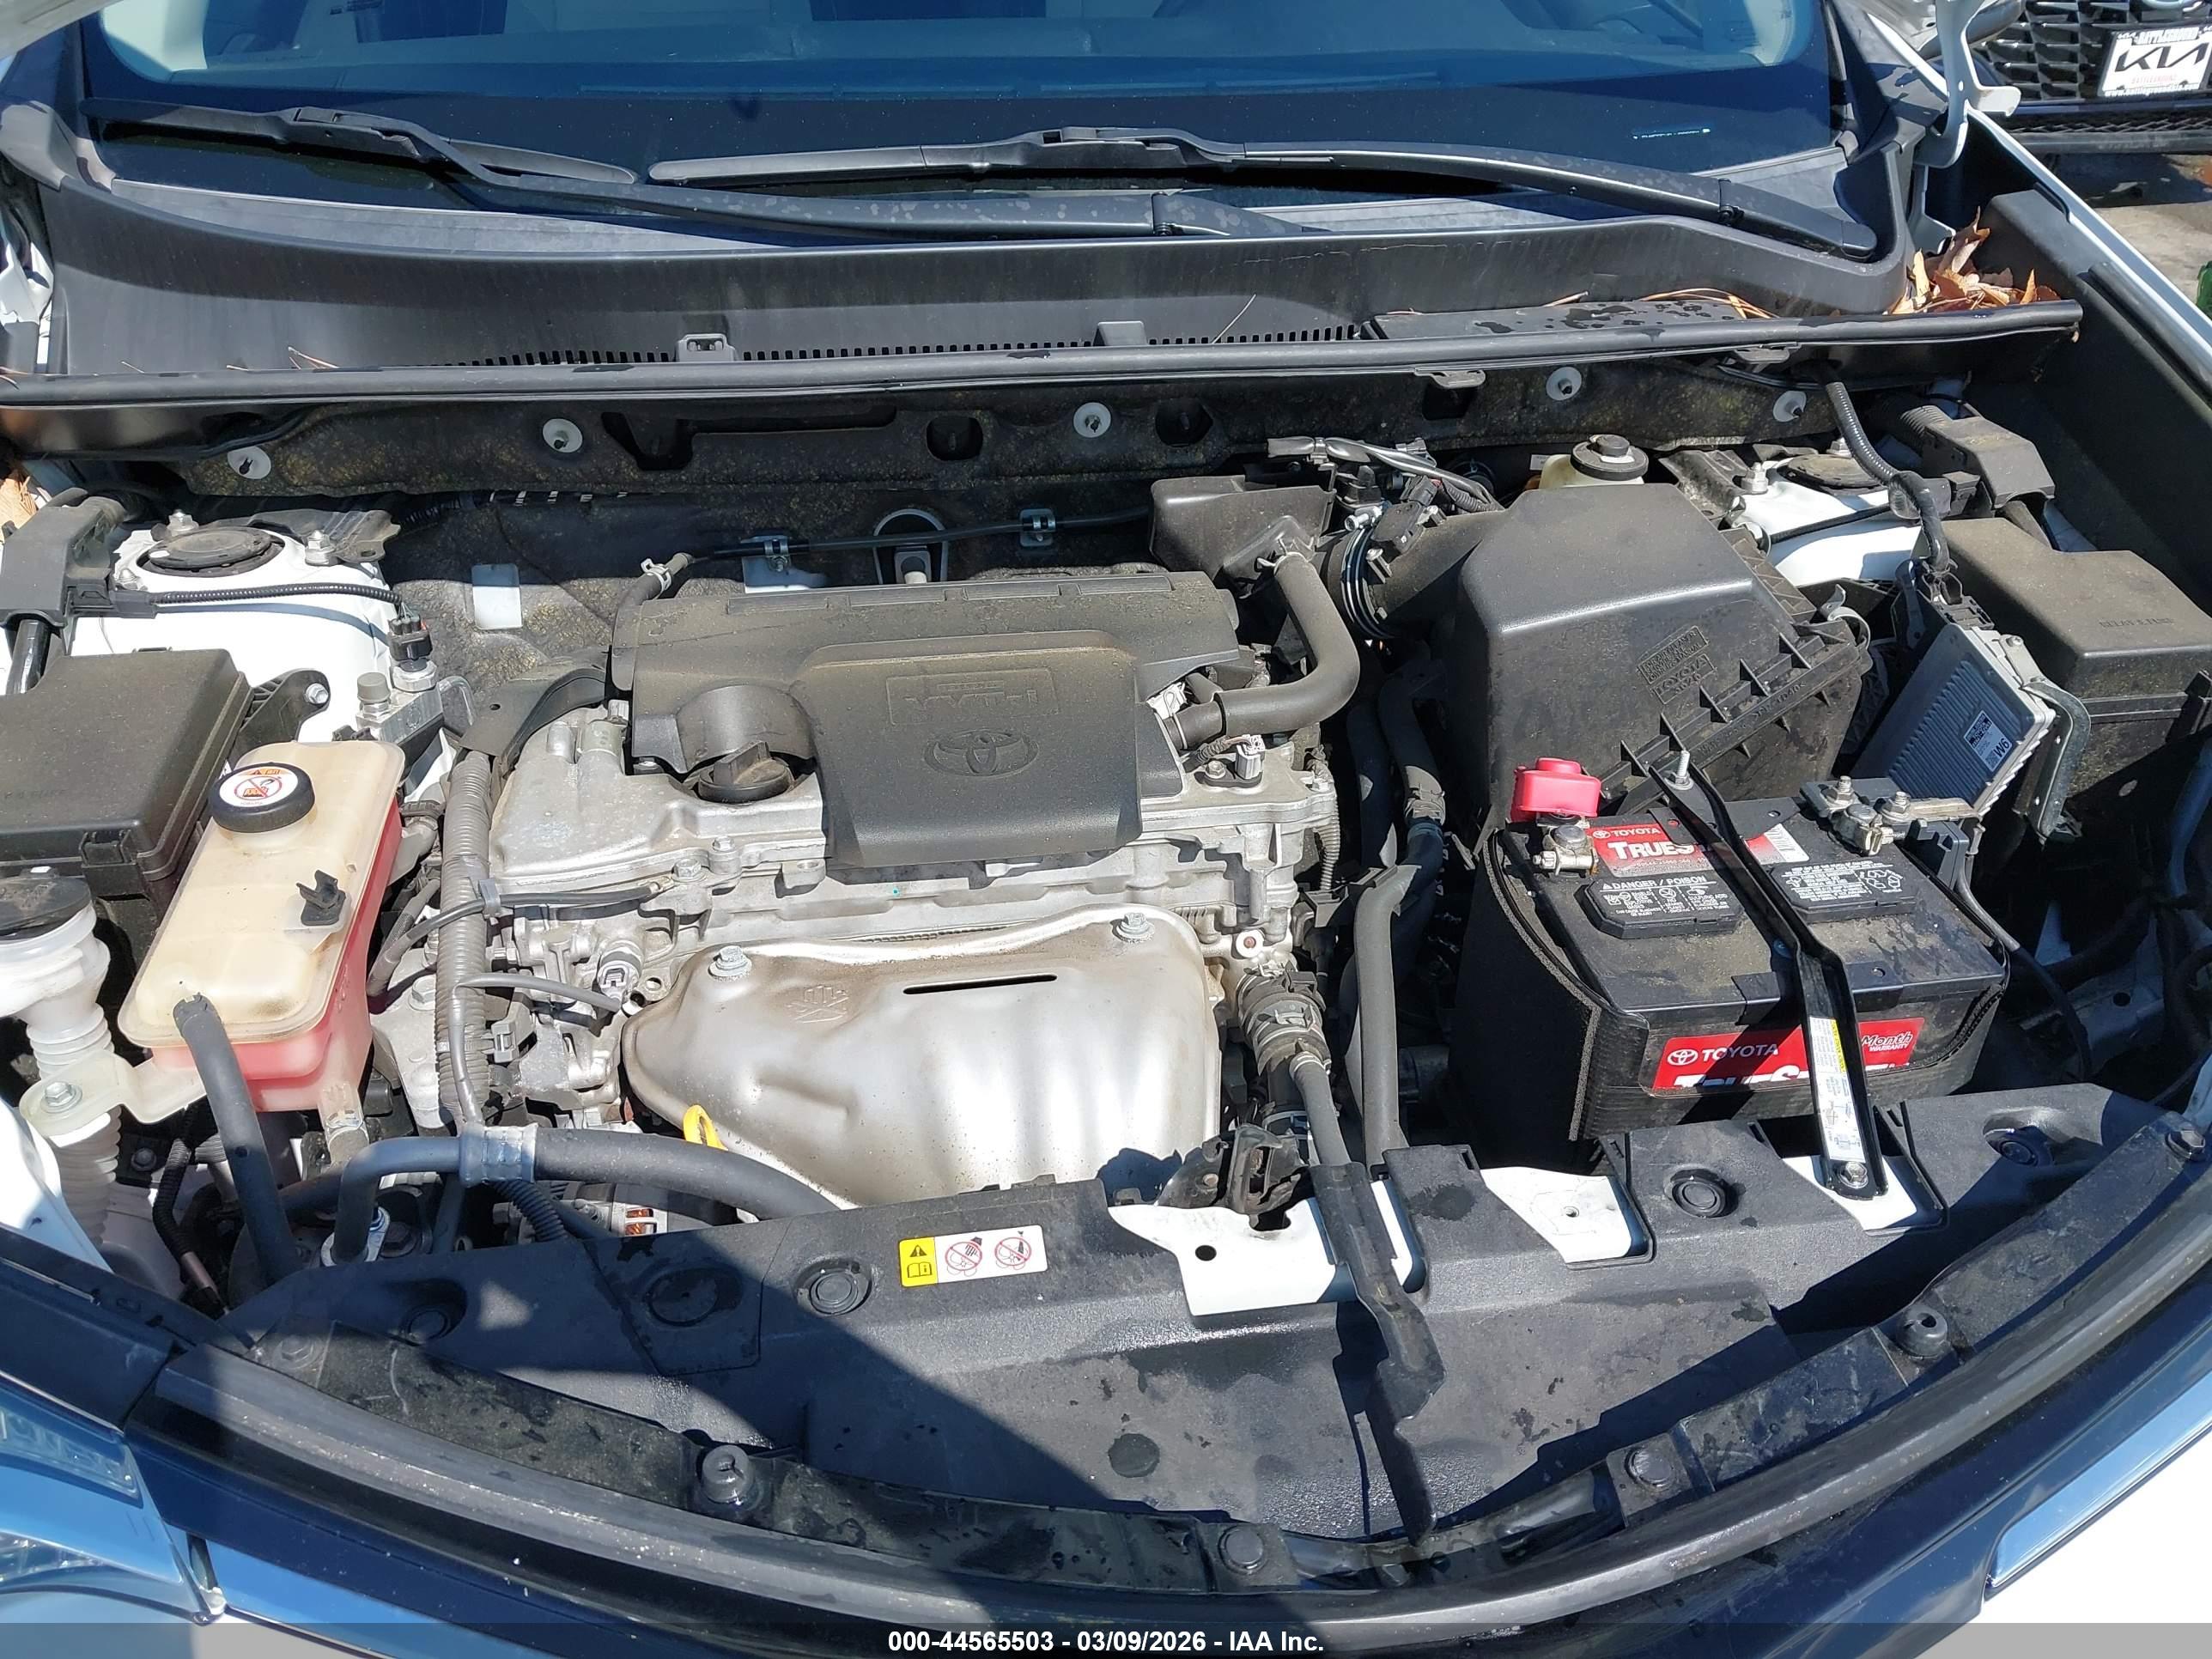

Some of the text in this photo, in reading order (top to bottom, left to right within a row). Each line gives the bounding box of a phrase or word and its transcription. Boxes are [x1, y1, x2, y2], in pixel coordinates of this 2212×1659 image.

[1611, 827, 1662, 837] TOYOTA
[1613, 878, 1656, 890] DANGER
[1666, 875, 1706, 885] POISON
[1861, 1031, 1914, 1047] Month
[1702, 1043, 1779, 1062] TOYOTA
[1869, 1042, 1910, 1053] WARRANTY
